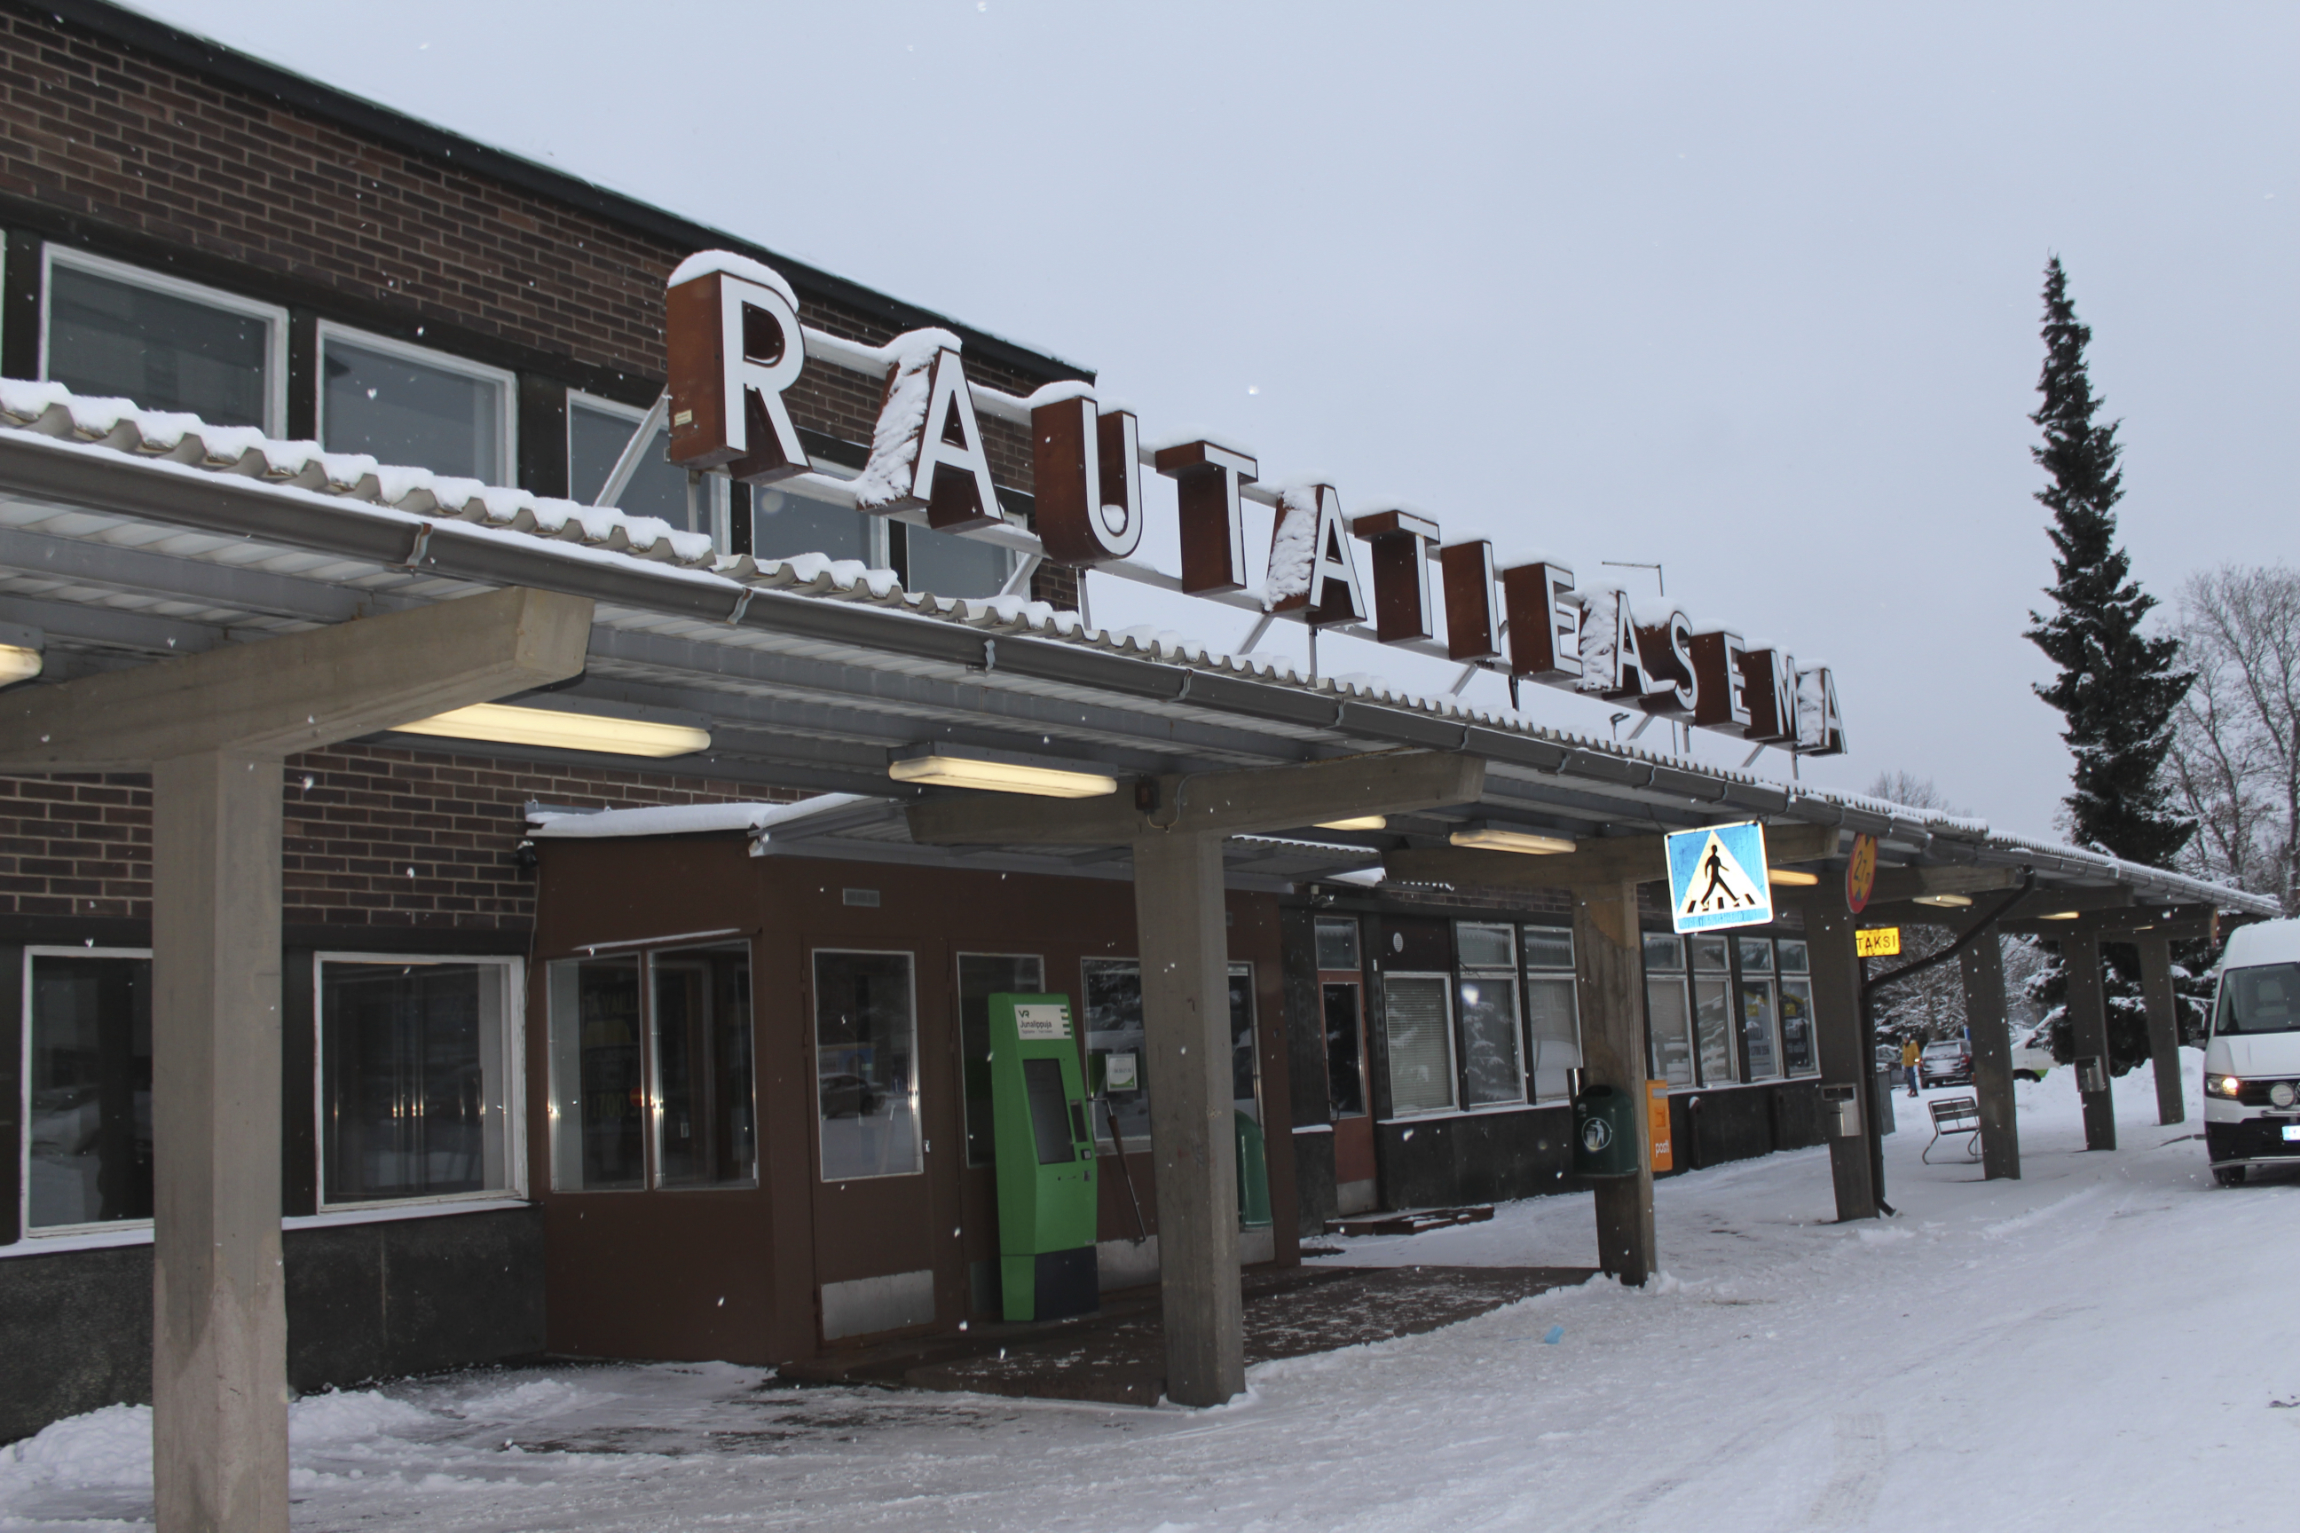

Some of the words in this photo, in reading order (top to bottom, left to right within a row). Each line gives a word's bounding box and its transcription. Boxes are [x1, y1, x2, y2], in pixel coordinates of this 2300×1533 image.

[712, 268, 1848, 756] RAUTATIEASEMA
[1856, 934, 1896, 951] TAKSI
[1018, 1009, 1030, 1018] VR
[1655, 1139, 1670, 1158] posti
